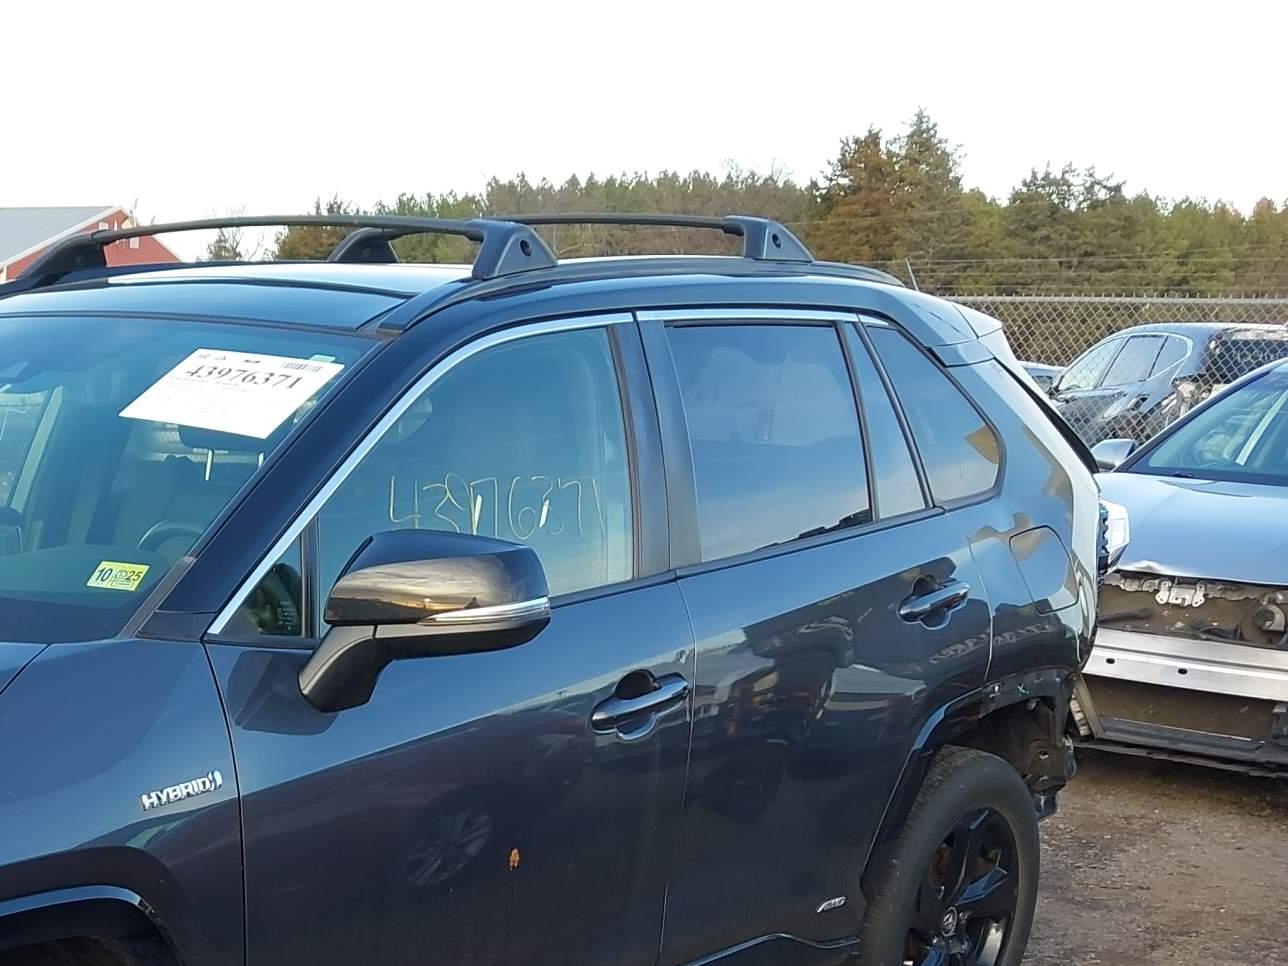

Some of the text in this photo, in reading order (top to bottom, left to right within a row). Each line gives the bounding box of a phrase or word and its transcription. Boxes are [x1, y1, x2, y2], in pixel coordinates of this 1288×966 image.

[186, 365, 304, 389] 43976371
[95, 567, 143, 582] 10 25
[141, 777, 214, 809] HYBRID
